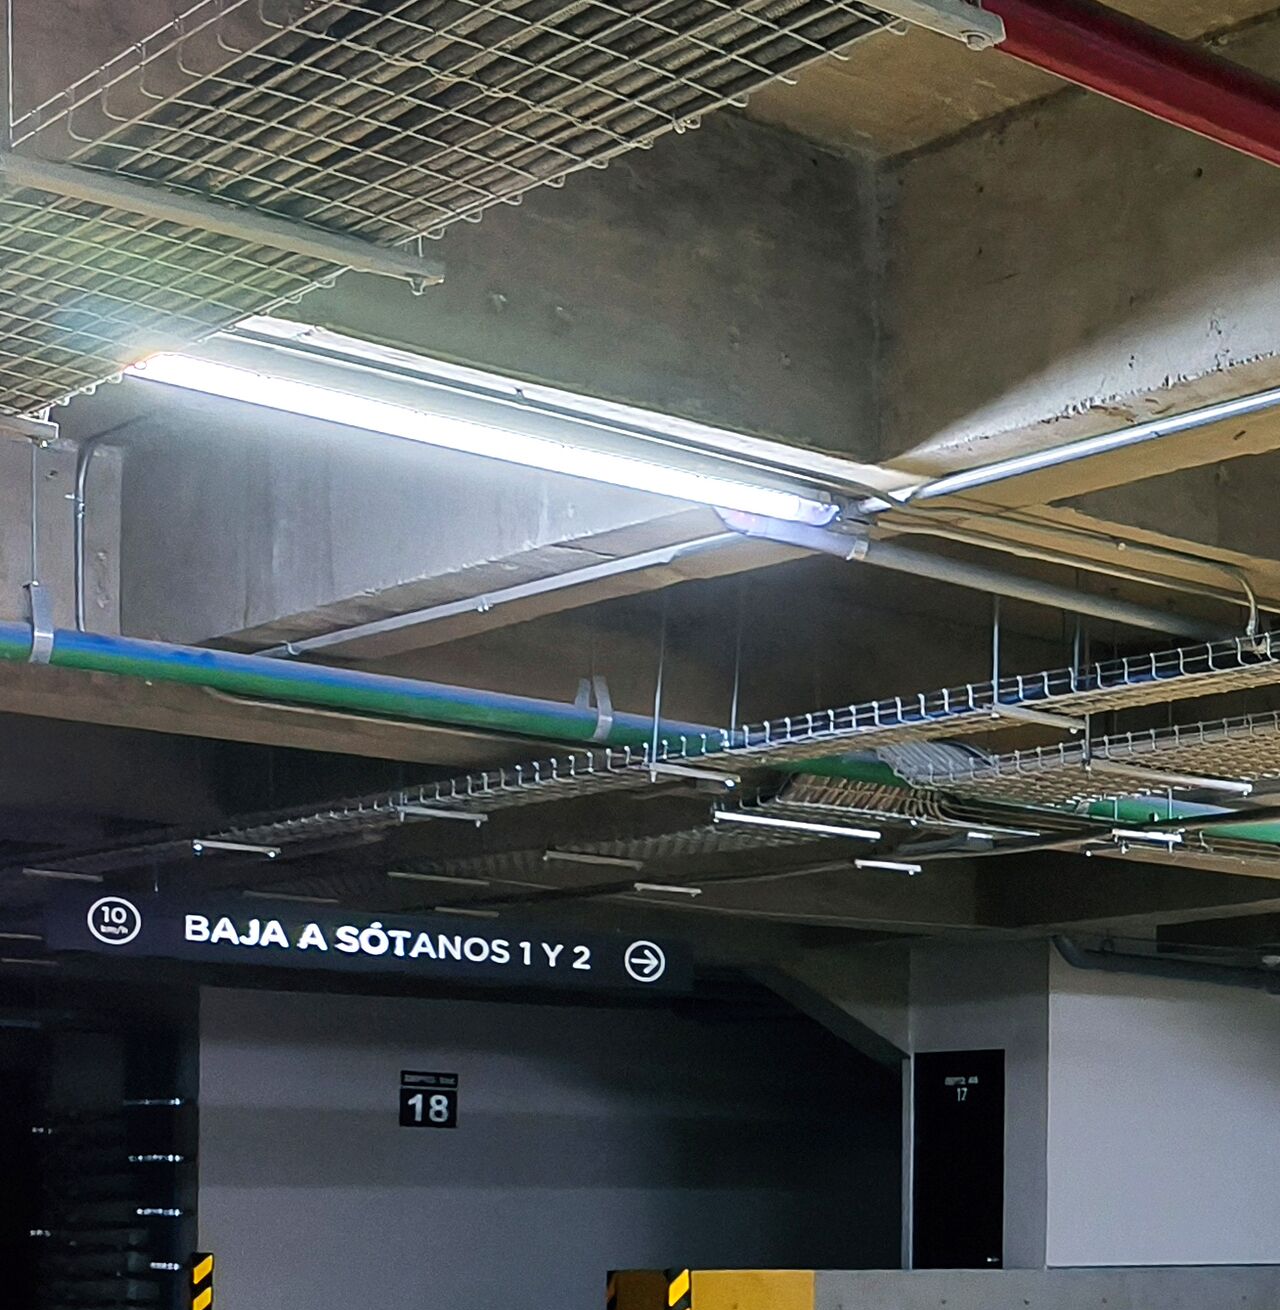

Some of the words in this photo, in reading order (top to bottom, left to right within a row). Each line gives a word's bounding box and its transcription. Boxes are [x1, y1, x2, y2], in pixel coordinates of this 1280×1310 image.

[101, 906, 127, 924] 10
[185, 914, 289, 948] BAJA
[297, 923, 328, 951] A
[334, 922, 510, 963] SÓTANOS
[519, 941, 531, 966] 1
[541, 942, 565, 968] Y
[572, 945, 592, 970] 2
[408, 1093, 449, 1122] 18
